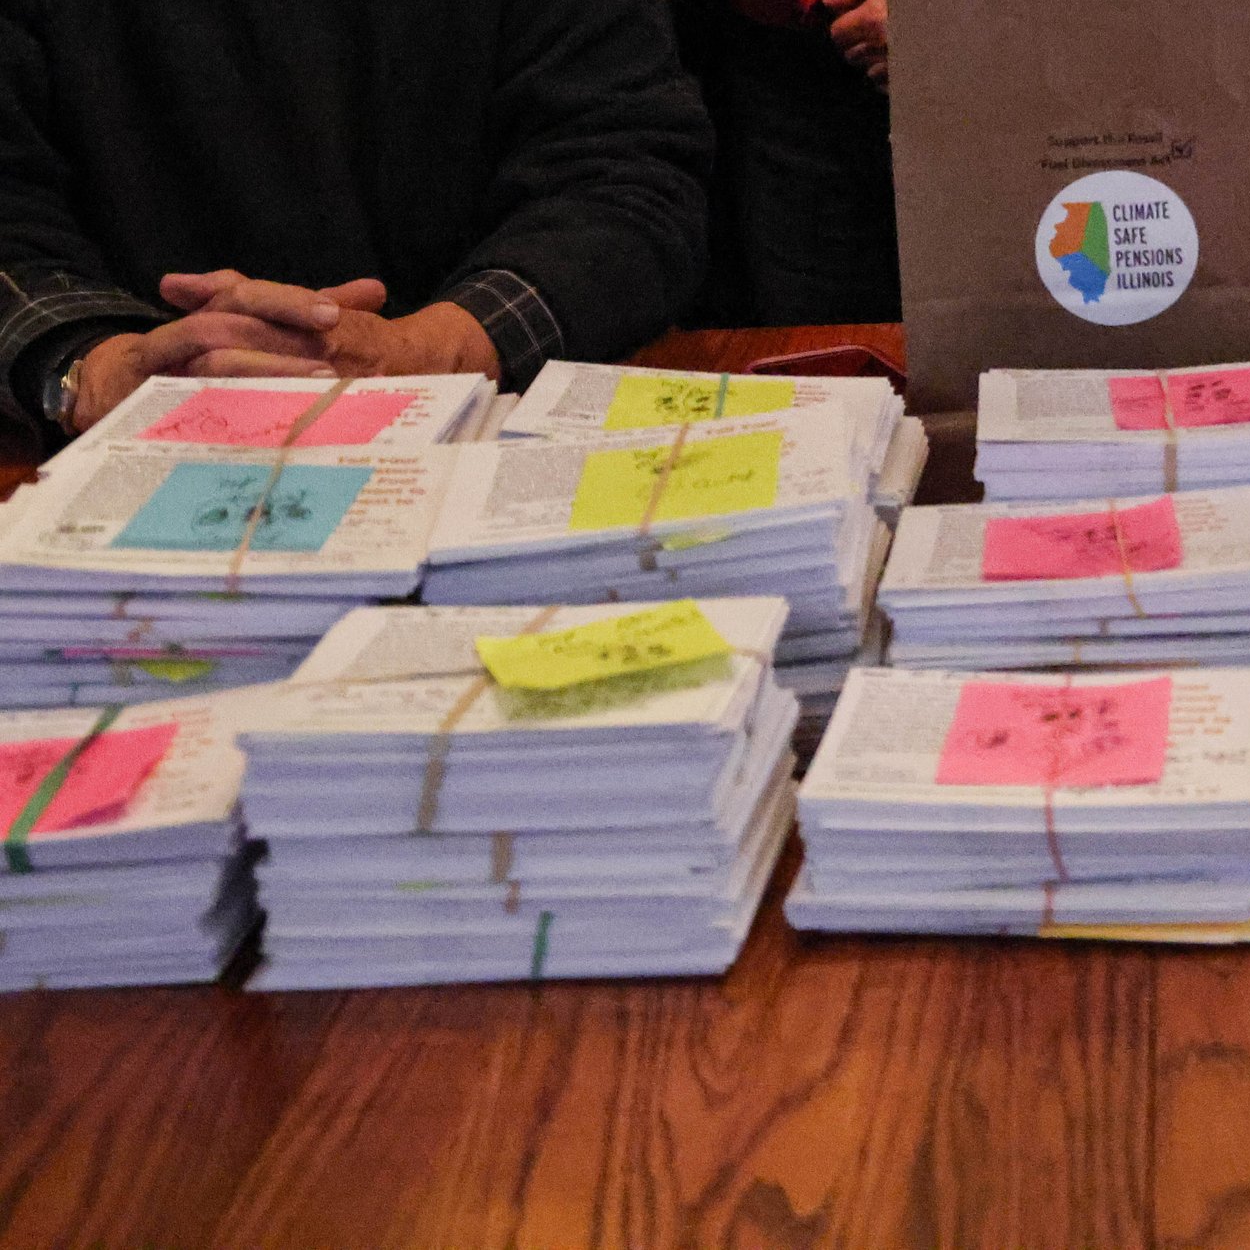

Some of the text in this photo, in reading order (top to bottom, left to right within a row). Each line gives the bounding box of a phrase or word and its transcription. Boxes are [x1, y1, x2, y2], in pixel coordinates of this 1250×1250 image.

[1113, 202, 1170, 222] CLIMATE
[1114, 227, 1147, 245] SAFE
[1116, 248, 1183, 268] PENSIONS
[1117, 271, 1174, 289] ILLINOIS
